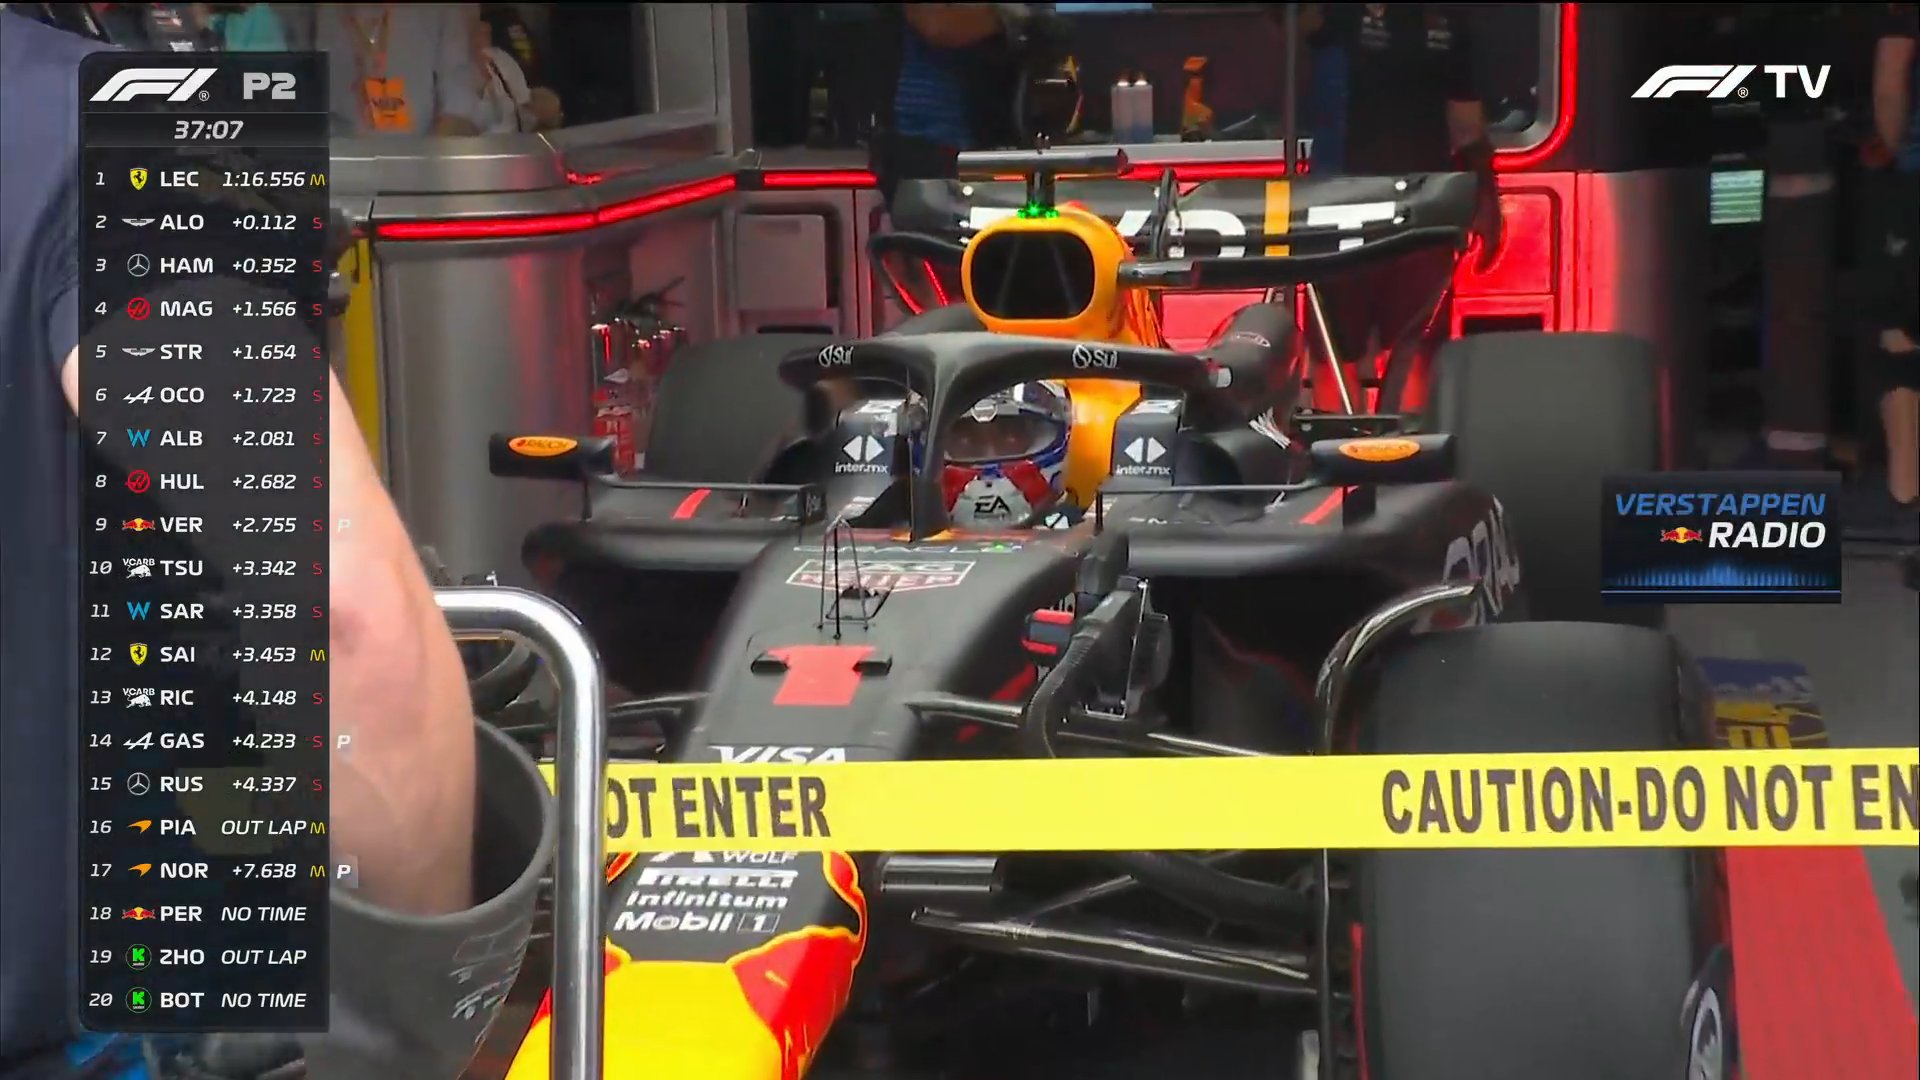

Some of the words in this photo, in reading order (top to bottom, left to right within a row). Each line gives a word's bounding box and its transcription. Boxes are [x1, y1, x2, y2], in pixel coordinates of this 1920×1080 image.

[835, 461, 889, 474] inter.mx
[1115, 464, 1172, 476] inter.mx
[973, 495, 1012, 514] EA
[767, 644, 875, 706] 1
[706, 745, 847, 764] VISA
[606, 777, 657, 839] OT
[672, 776, 831, 838] ENTER
[1382, 766, 1706, 834] CAUTION-DO
[1724, 765, 1833, 831] NOT
[637, 867, 799, 888] PIRELLI
[626, 890, 789, 910] Infinitum
[613, 911, 734, 932] Mobil
